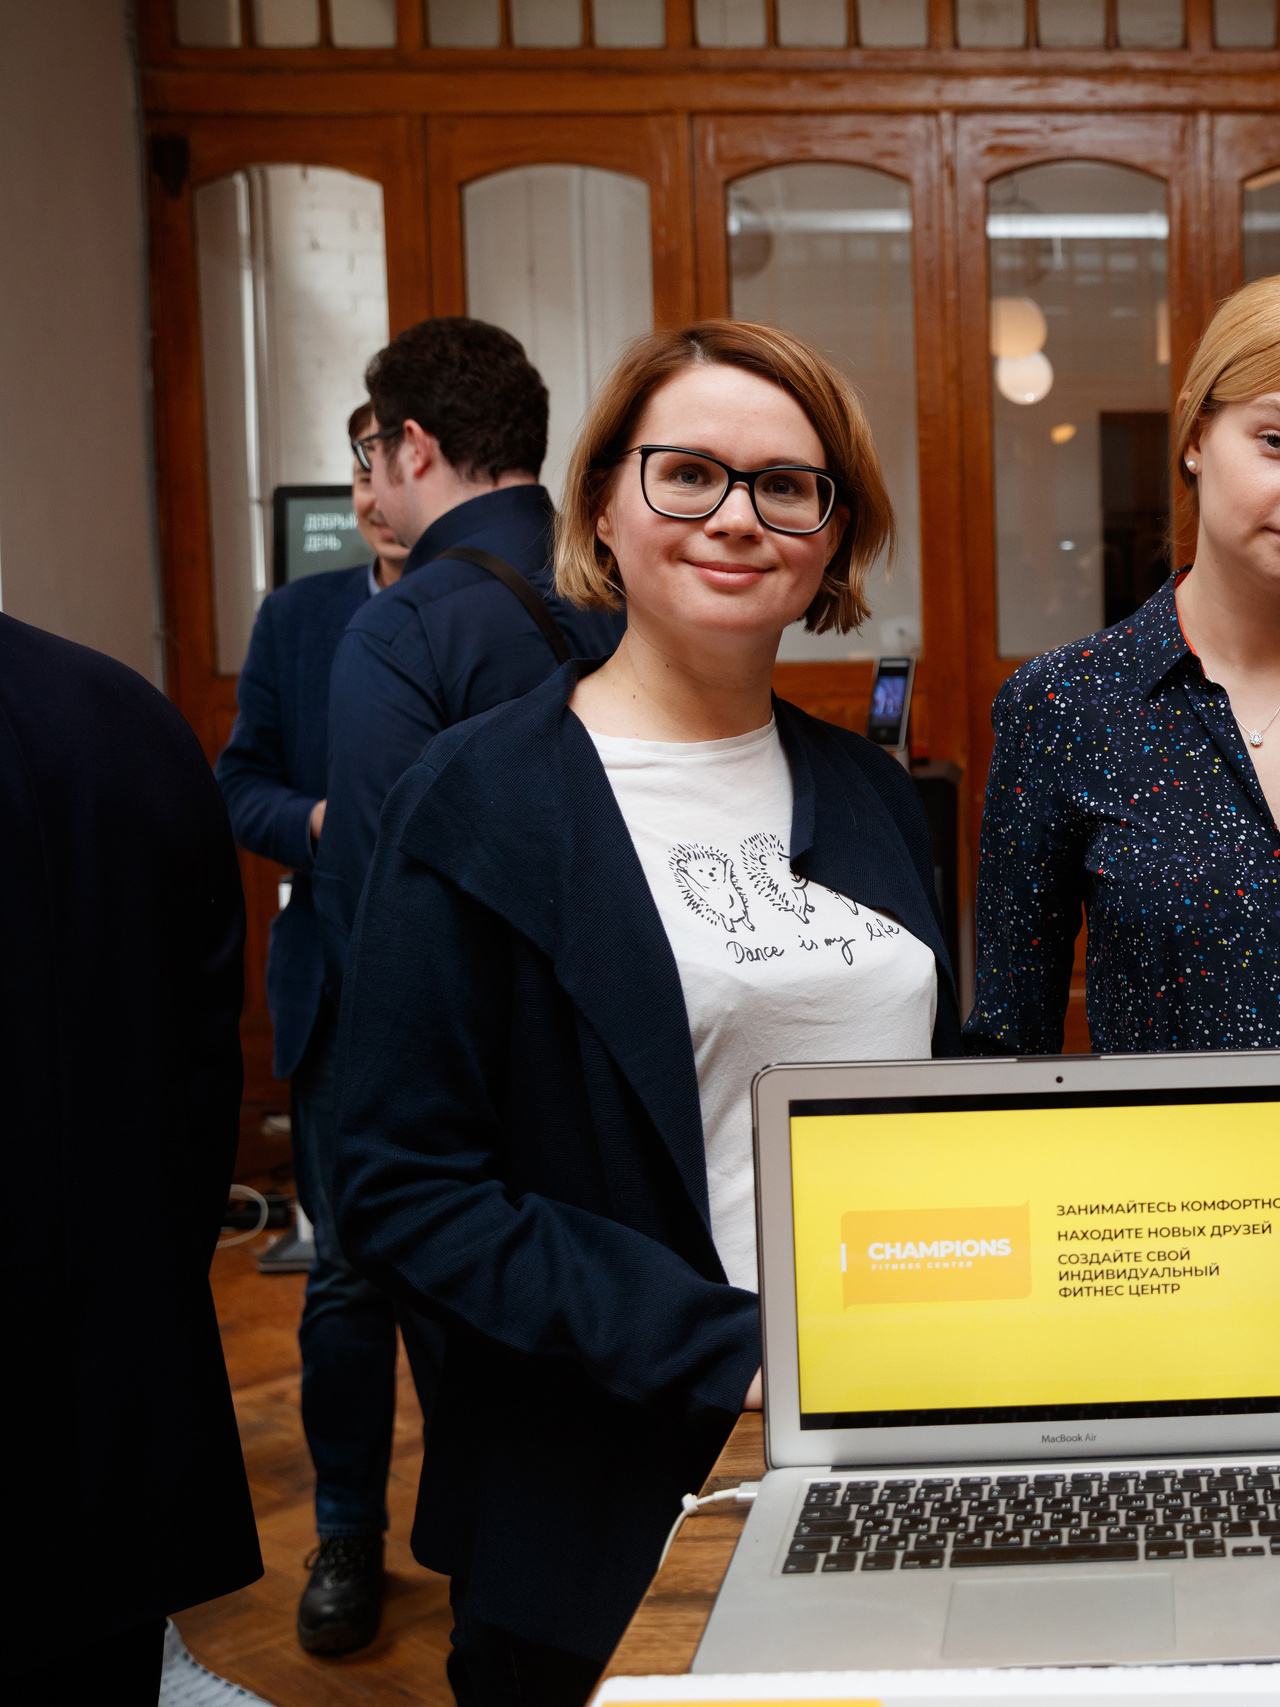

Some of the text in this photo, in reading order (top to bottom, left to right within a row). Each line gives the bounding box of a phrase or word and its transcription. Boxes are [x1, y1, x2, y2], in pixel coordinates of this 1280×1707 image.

[726, 919, 900, 965] Dance is my life
[1057, 1200, 1176, 1216] ЗАНИМАЙТЕСЬ
[1058, 1221, 1272, 1242] НАХОДИТЕ НОВЫХ ДРУЗЕЙ
[868, 1239, 1011, 1260] CHAMPIONS
[1058, 1247, 1190, 1265] СОЗДАЙТЕ СВОЙ
[927, 1261, 972, 1269] CENTER
[1059, 1263, 1219, 1282] ИНДИВИДУАЛЬНЫЙ
[1059, 1284, 1180, 1297] ФИТНЕС ЦЕНТР
[1042, 1433, 1097, 1442] MacBook Air
